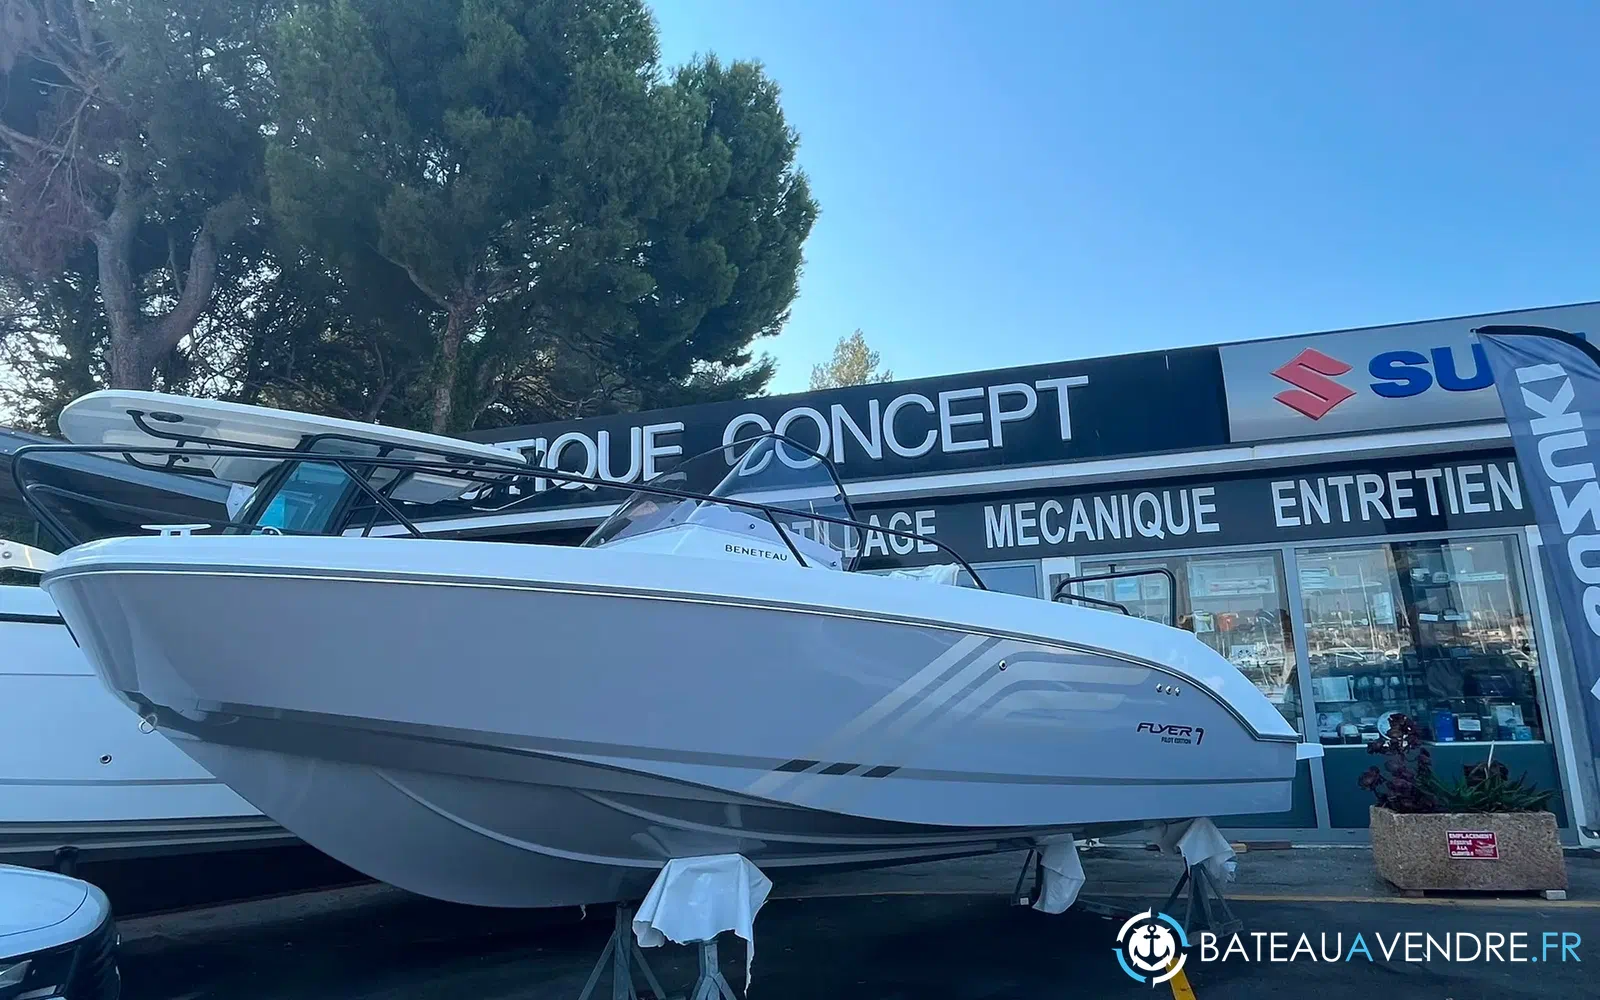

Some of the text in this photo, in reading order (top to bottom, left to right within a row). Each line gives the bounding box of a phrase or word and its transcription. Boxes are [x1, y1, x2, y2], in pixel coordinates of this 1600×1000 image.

[1368, 343, 1495, 398] SU
[722, 375, 1090, 477] CONCEPT
[984, 487, 1220, 549] MECANIQUE
[1271, 462, 1523, 527] ENTRETIEN
[725, 544, 788, 561] BENETEAU
[1136, 722, 1193, 737] FLYER
[1161, 736, 1173, 744] PILOT
